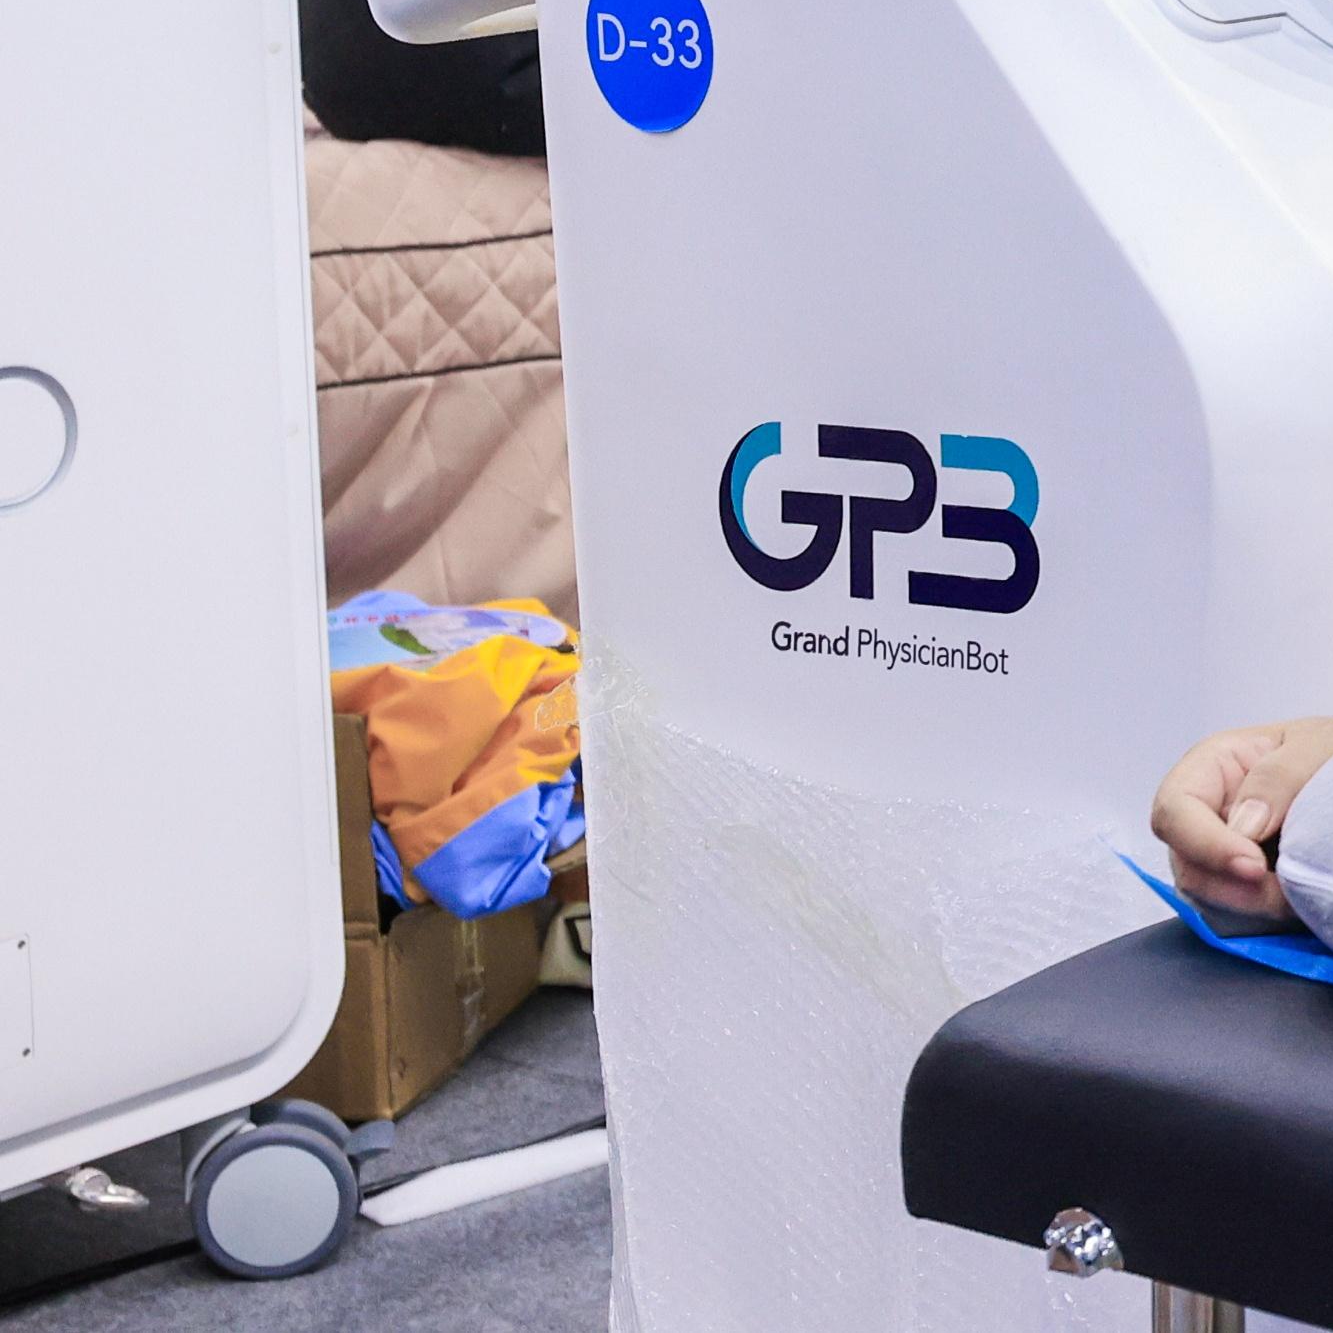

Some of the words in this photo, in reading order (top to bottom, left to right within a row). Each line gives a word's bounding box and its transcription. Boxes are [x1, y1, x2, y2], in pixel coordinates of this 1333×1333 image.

[597, 12, 703, 69] D-33
[719, 421, 1040, 614] GPB
[771, 621, 849, 656] Grand
[857, 628, 1009, 675] PhysicianBot
